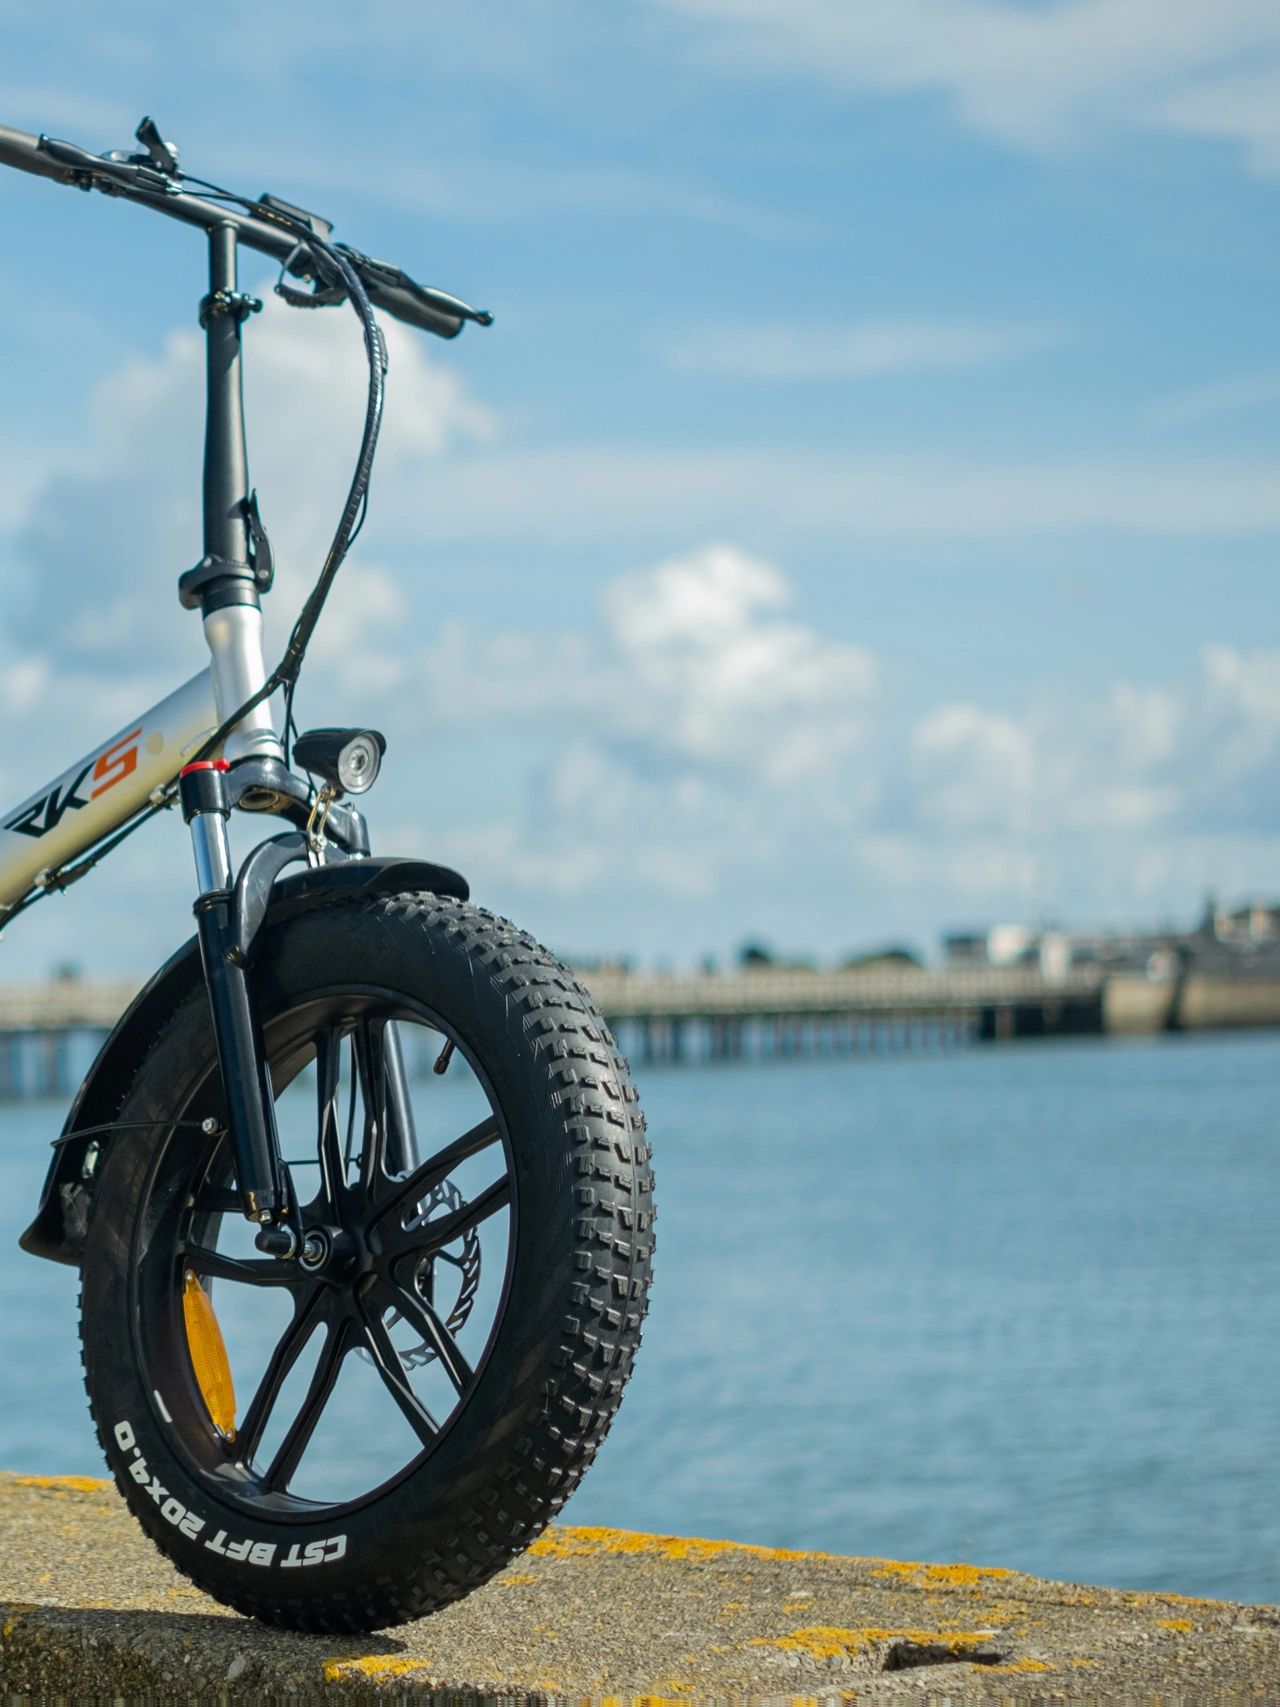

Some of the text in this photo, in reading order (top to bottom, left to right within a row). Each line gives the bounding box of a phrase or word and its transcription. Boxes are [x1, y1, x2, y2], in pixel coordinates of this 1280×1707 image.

[3, 727, 144, 838] RKS
[205, 1529, 277, 1567] BFT
[280, 1534, 347, 1568] CST
